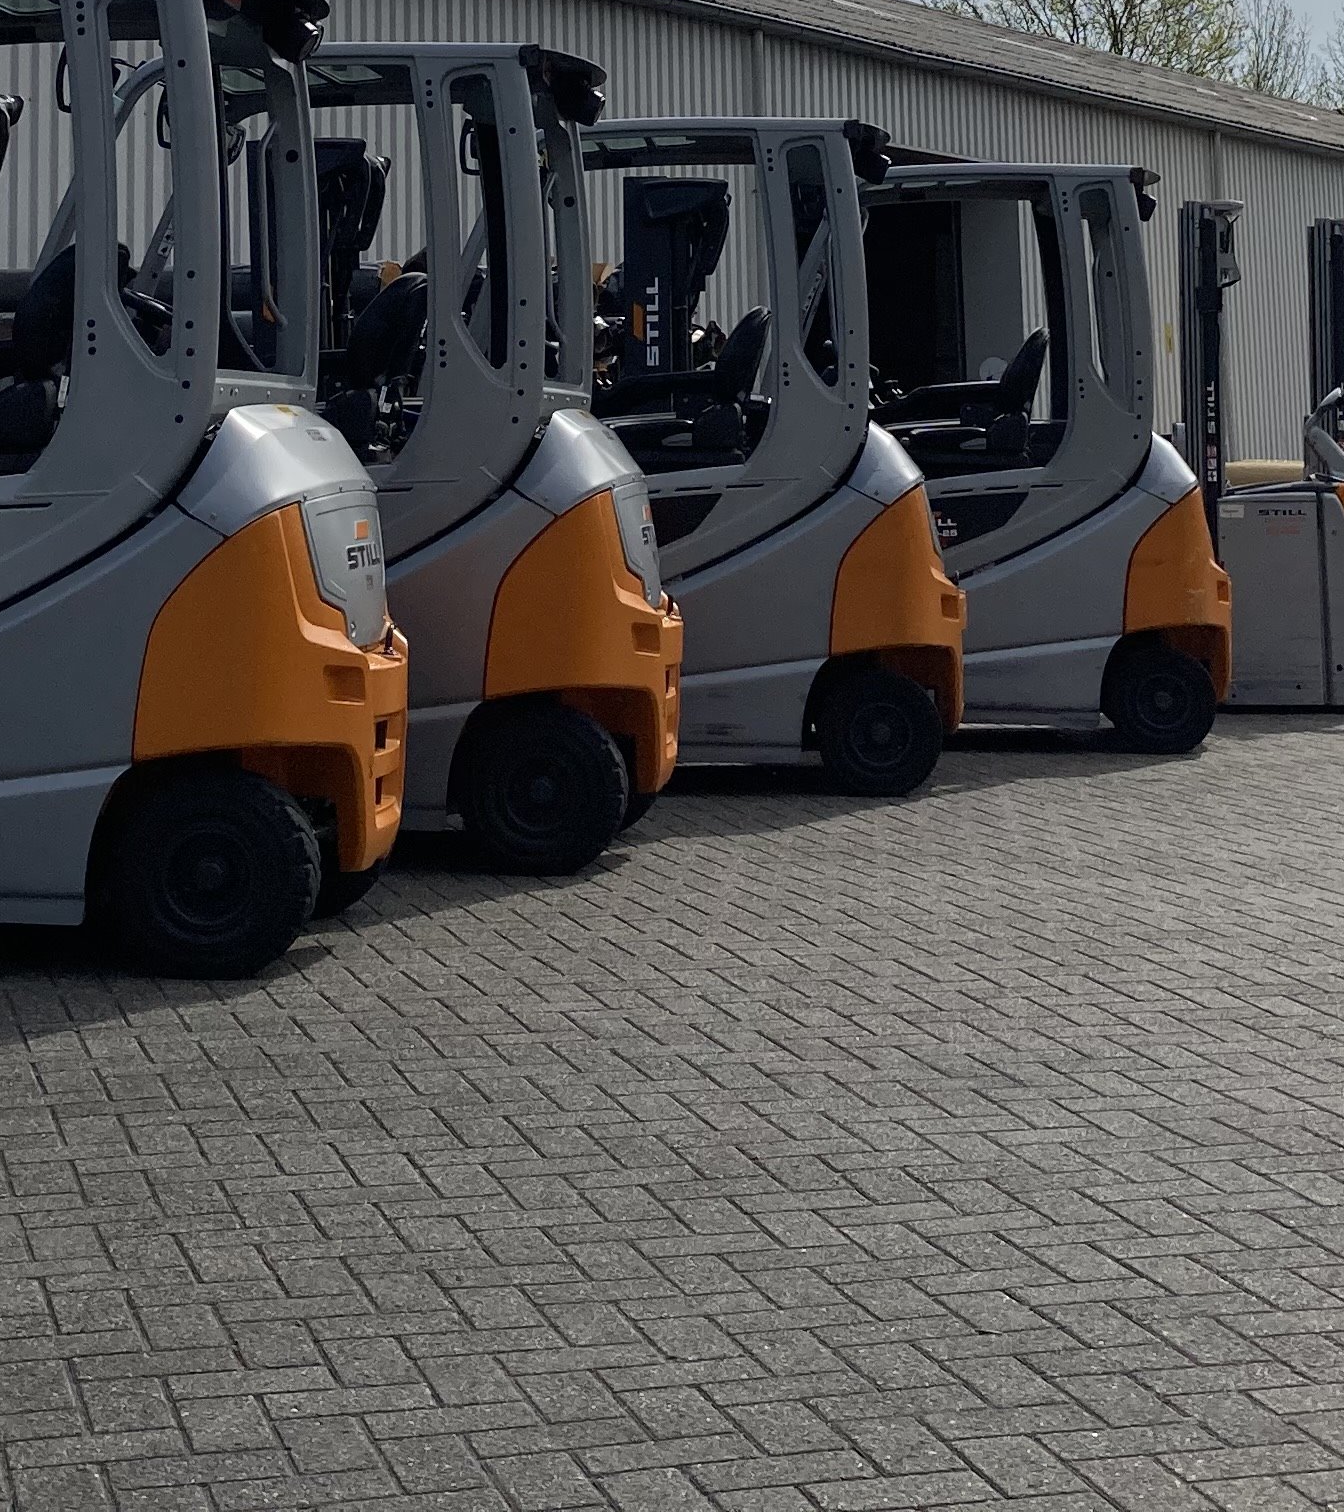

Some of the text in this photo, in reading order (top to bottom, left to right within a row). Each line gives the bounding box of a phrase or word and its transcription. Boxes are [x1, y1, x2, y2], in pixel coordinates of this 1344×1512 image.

[646, 277, 660, 367] STILL
[1206, 380, 1217, 435] STILL
[346, 543, 381, 570] STILL
